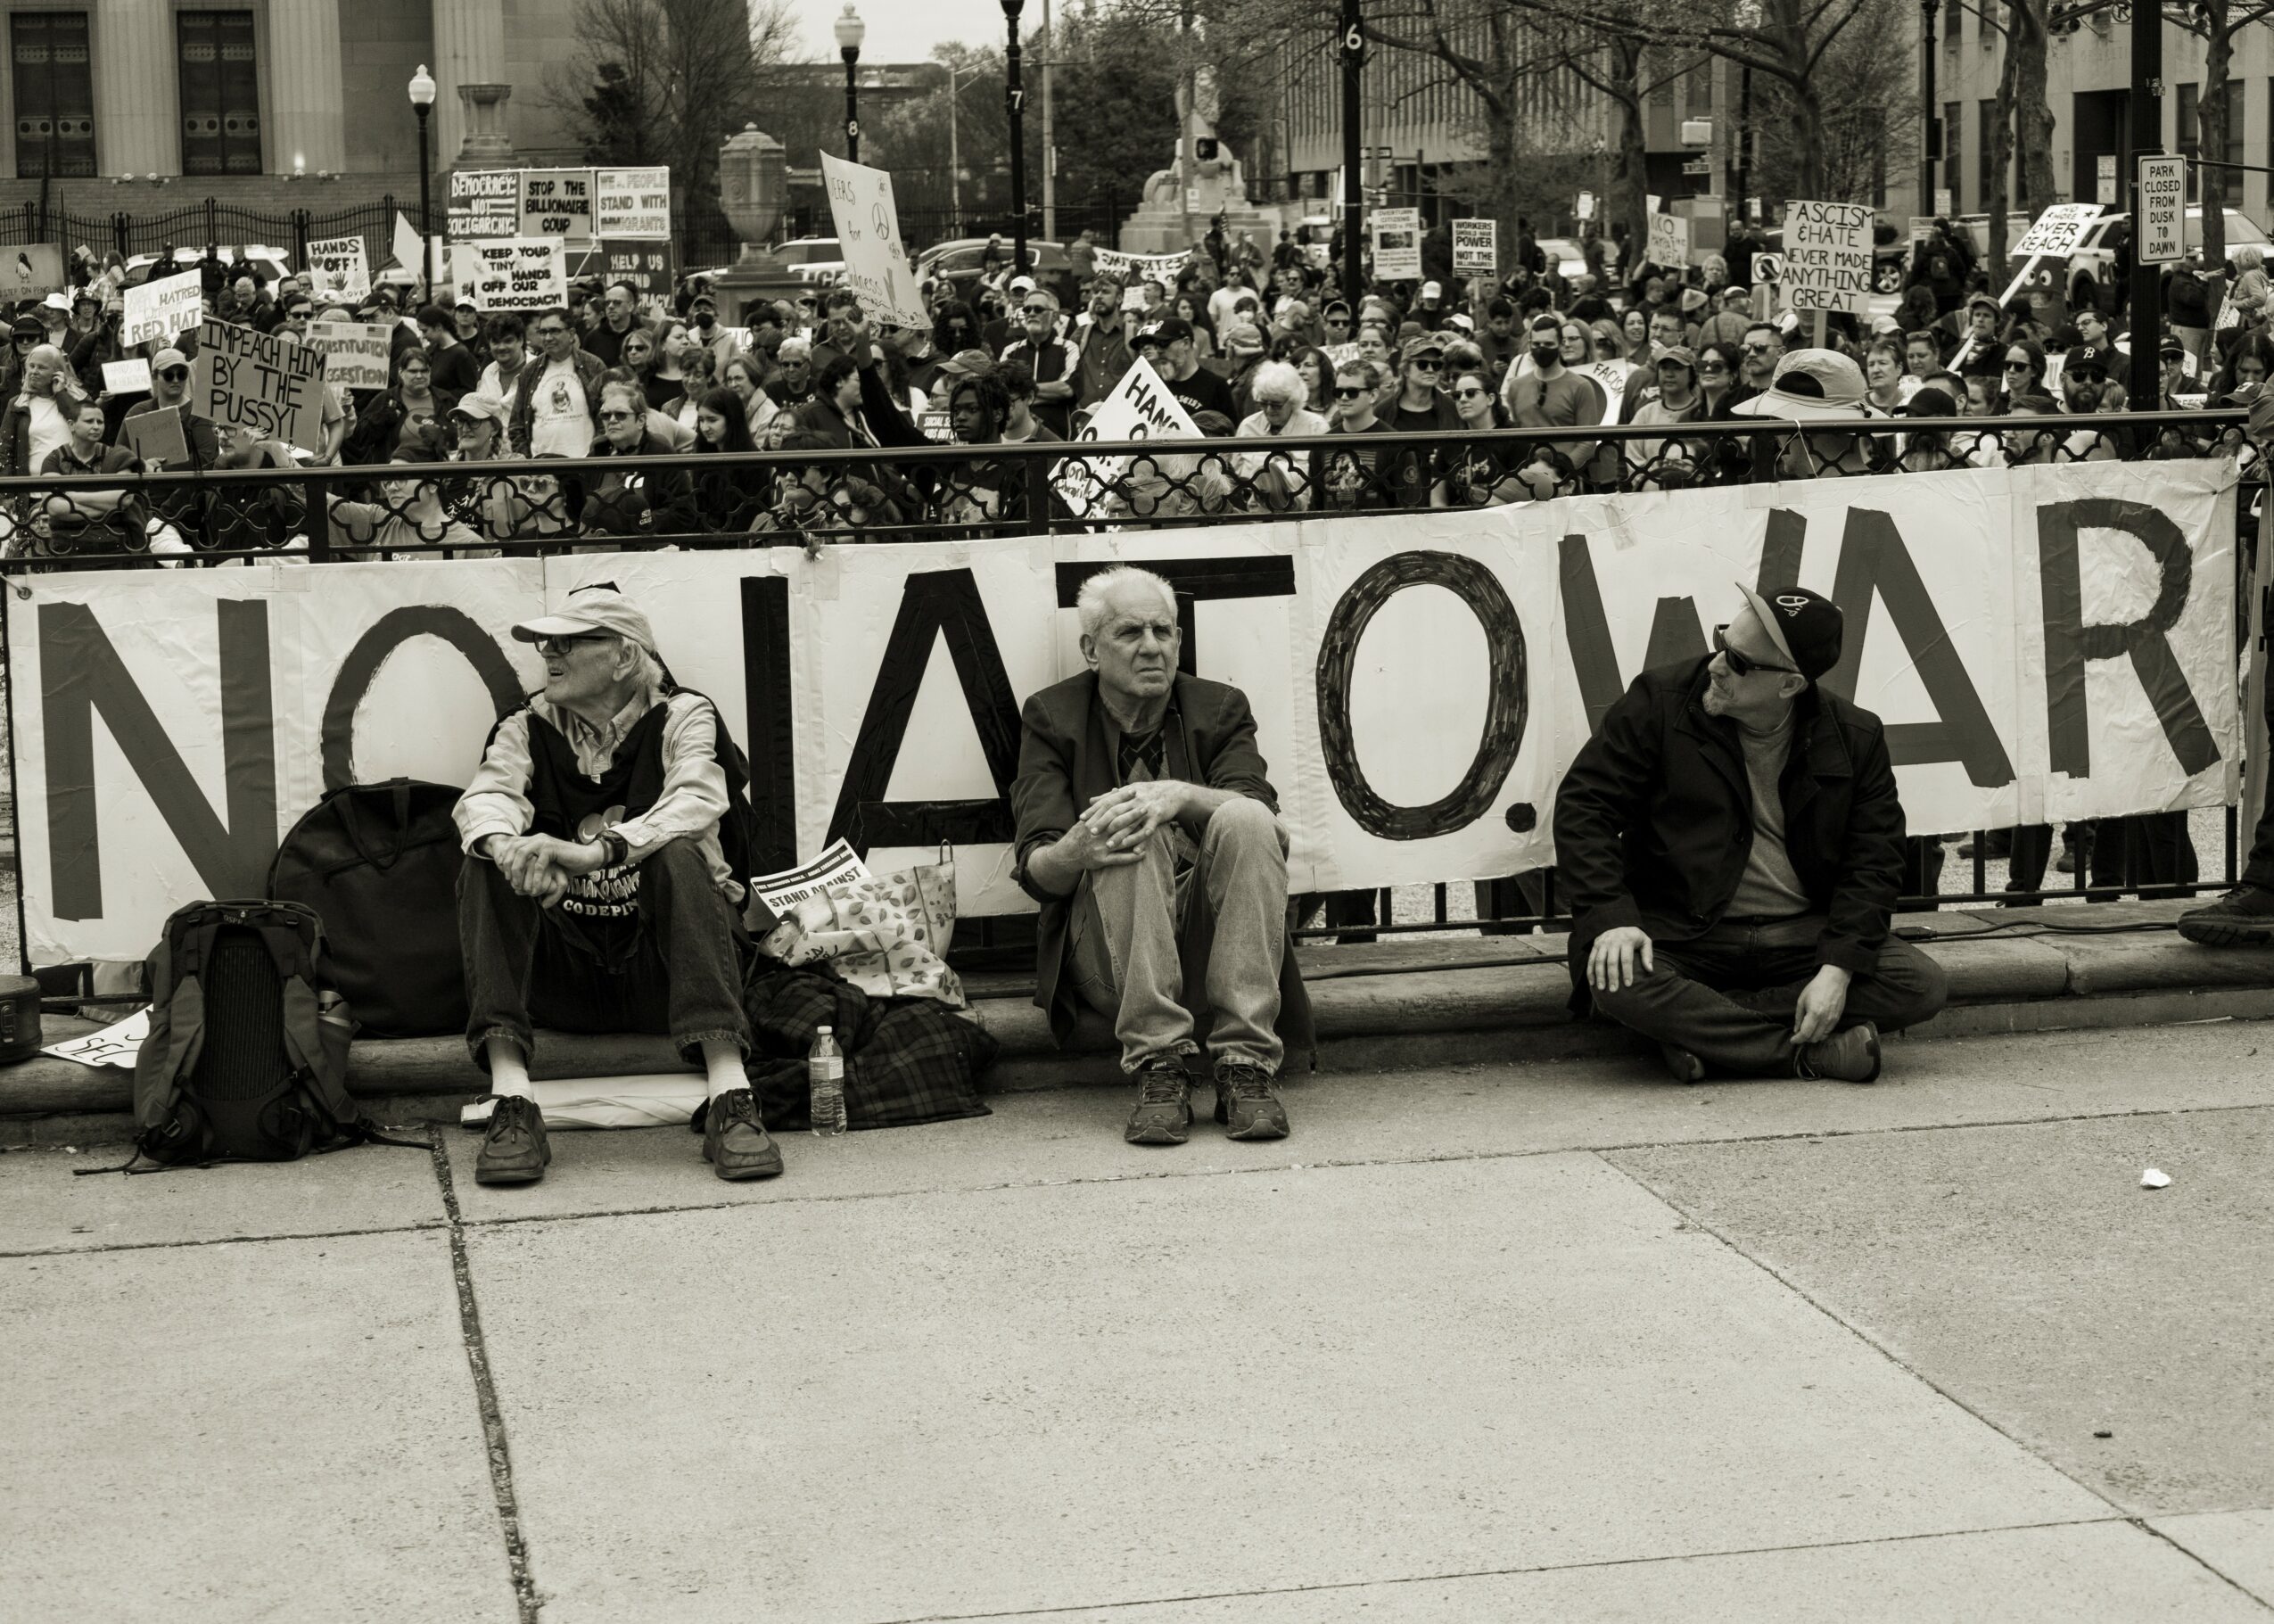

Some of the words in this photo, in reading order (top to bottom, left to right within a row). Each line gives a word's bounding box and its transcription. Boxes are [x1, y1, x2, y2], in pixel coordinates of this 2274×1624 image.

[1346, 23, 1362, 51] 6
[1010, 90, 1024, 110] 7
[849, 120, 858, 136] 8
[2150, 165, 2174, 177] PARK
[529, 181, 554, 196] STOP
[564, 180, 585, 195] THE
[627, 173, 667, 188] PEOPLE
[2145, 180, 2180, 193] CLOSED
[471, 198, 490, 215] NOT
[526, 198, 589, 214] BILLIONAIRE
[600, 195, 633, 210] STAND
[640, 194, 667, 210] WITH
[2150, 196, 2175, 208] FROM
[1784, 201, 1874, 229] FASCISM
[2150, 211, 2174, 223] DUSK
[542, 217, 571, 233] COUP
[1455, 221, 1492, 230] WORKERS
[2032, 222, 2079, 236] OVER
[2157, 227, 2168, 238] TO
[311, 238, 360, 256] HANDS
[1455, 236, 1493, 247] POWER
[2016, 236, 2074, 252] REACH
[2149, 242, 2175, 255] DAWN
[482, 248, 513, 259] KEEP
[518, 246, 550, 258] YOUR
[1456, 251, 1473, 260] NOT
[1477, 251, 1493, 260] THE
[1782, 247, 1829, 265] NEVER
[1835, 251, 1873, 270] MADE
[489, 260, 515, 271] TINY
[610, 253, 639, 270] HELP
[647, 254, 663, 271] US
[511, 268, 551, 281] HANDS
[1780, 267, 1870, 293] ANYTHING
[482, 280, 507, 293] OFF
[512, 280, 538, 292] OUR
[160, 285, 200, 307] HATRED
[487, 293, 562, 308] DEMOCRACY!
[1792, 288, 1858, 310] GREAT
[131, 320, 165, 343] RED
[169, 307, 199, 334] HAT
[201, 318, 281, 367] IMPEACH
[288, 344, 326, 382] HIM
[212, 355, 242, 390] BY
[253, 364, 307, 409] THE
[210, 389, 296, 444] PUSSY!
[1558, 498, 2222, 789] WAR
[769, 889, 810, 908] STAND
[563, 898, 639, 917] CODEPIN
